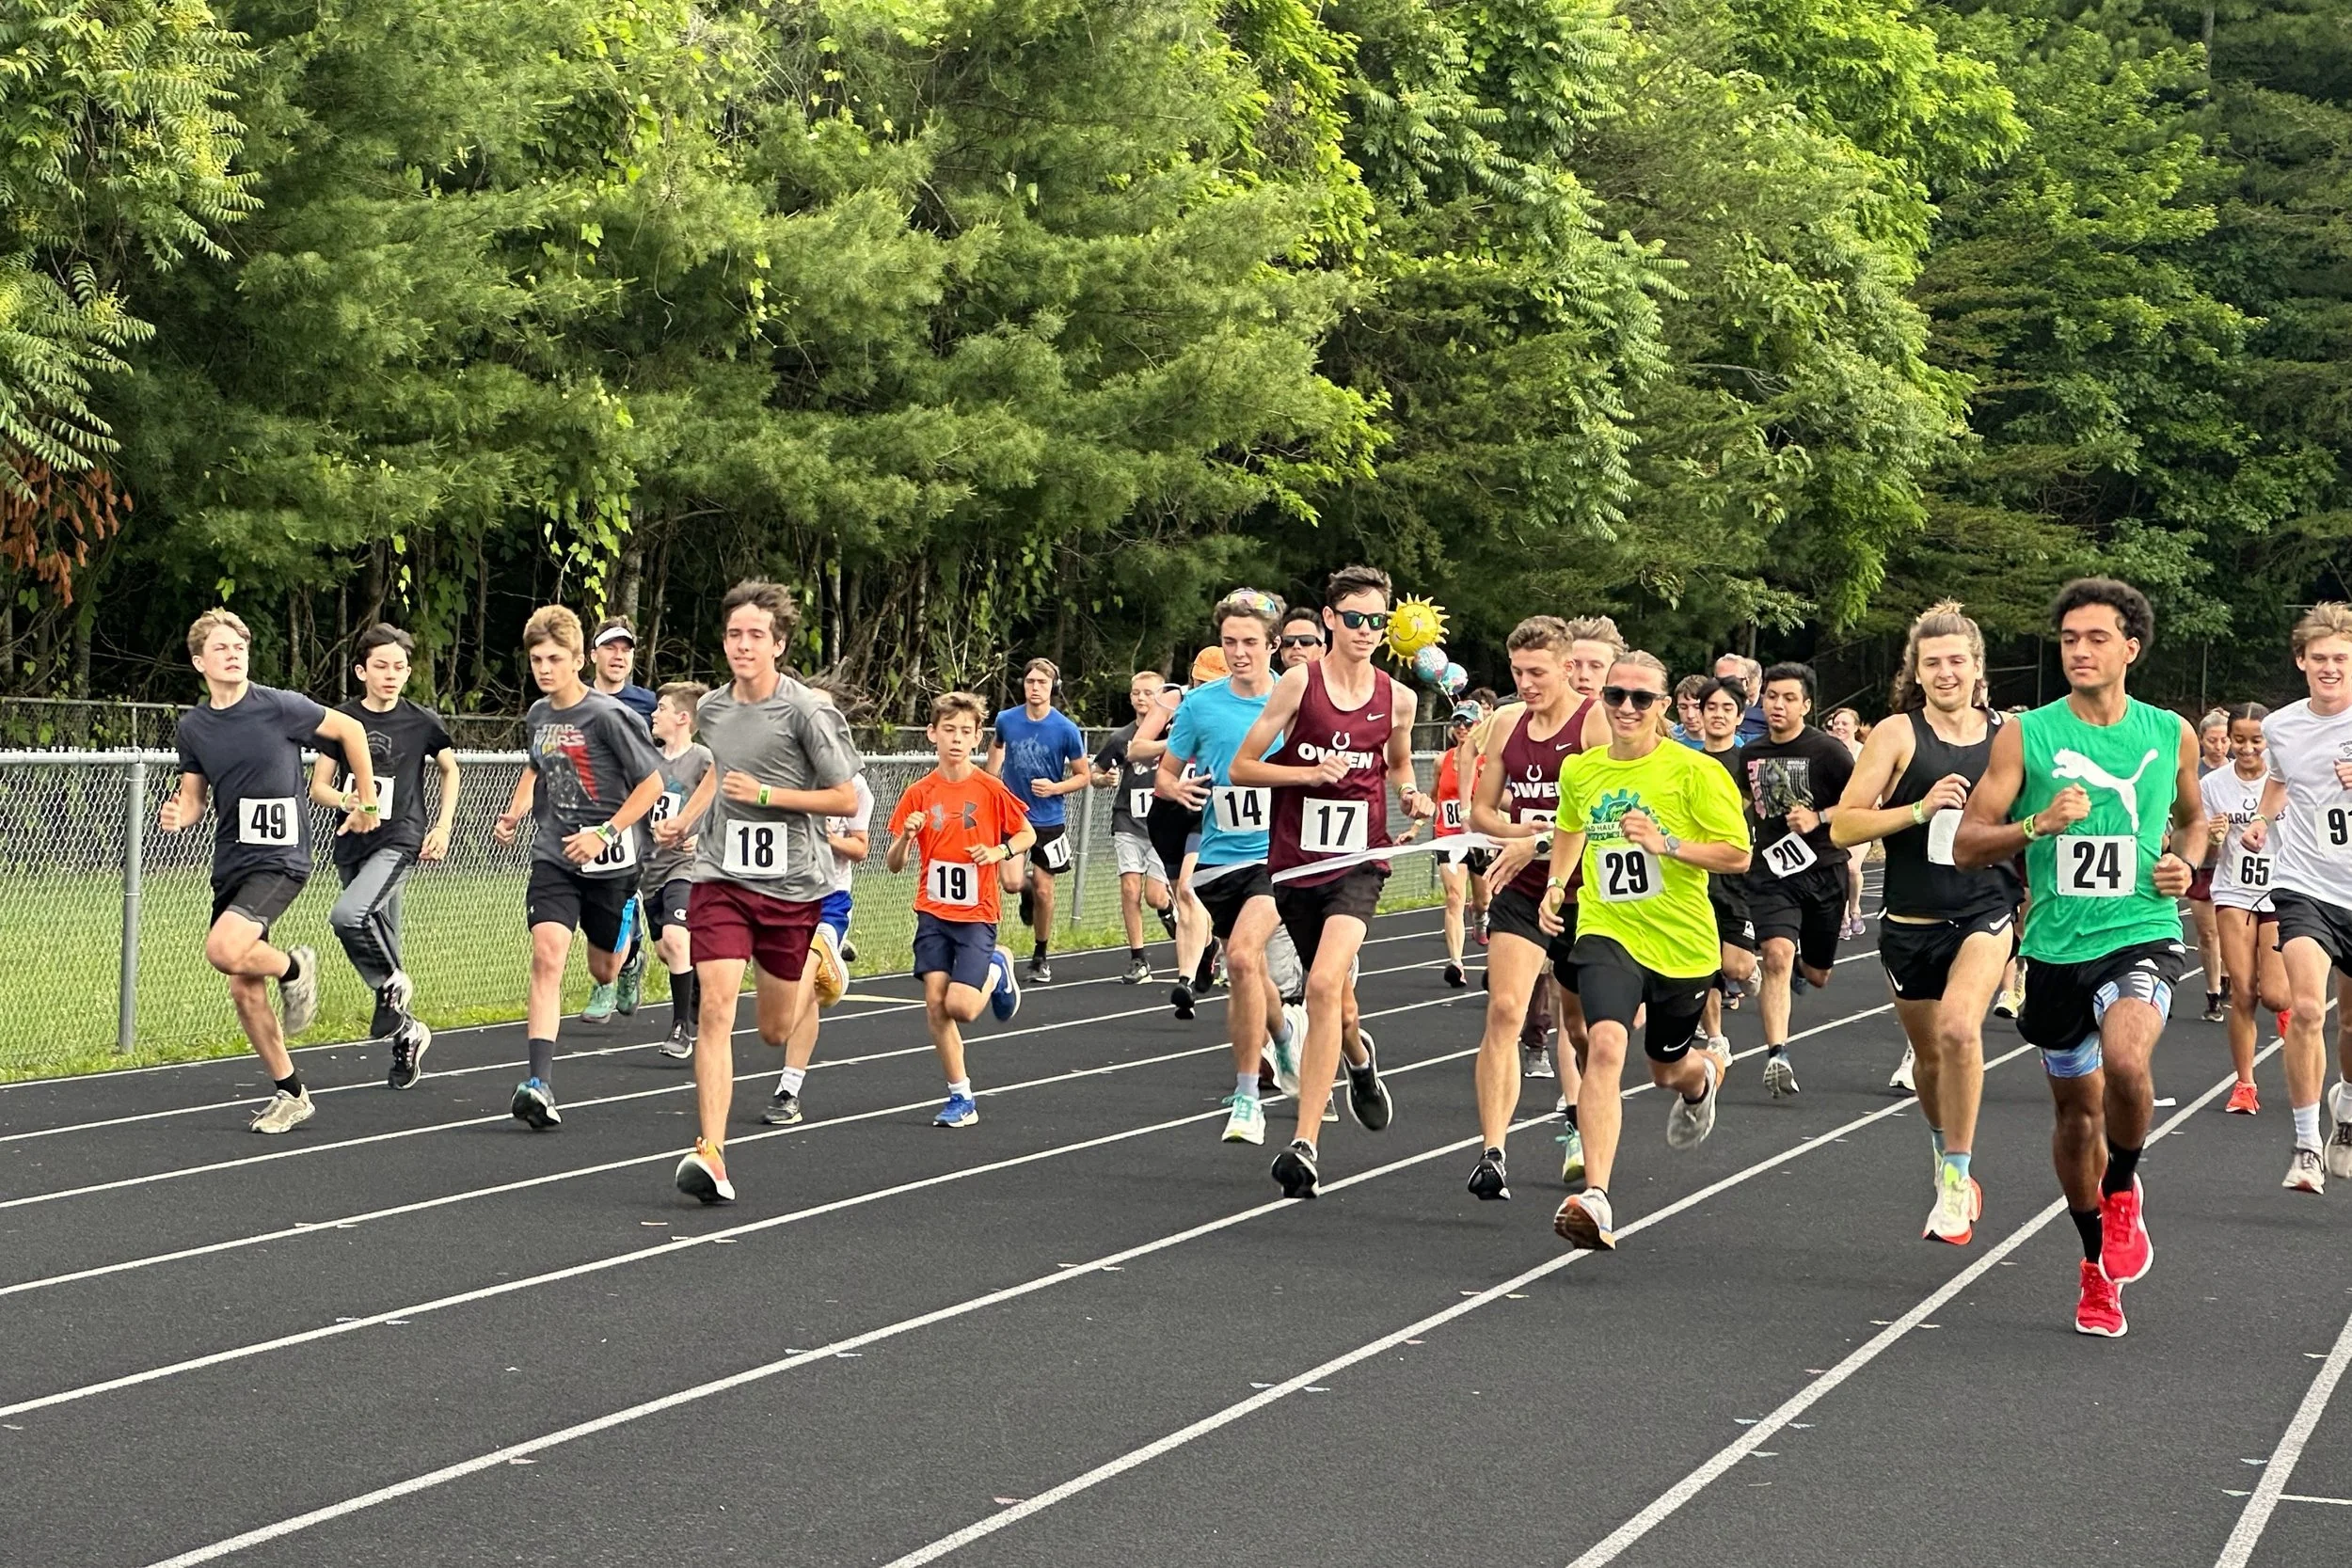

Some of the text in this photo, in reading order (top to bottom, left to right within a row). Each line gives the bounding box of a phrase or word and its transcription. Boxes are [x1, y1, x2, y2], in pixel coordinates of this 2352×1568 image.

[532, 732, 586, 749] WARS
[535, 723, 581, 734] STAR
[251, 803, 286, 839] 49
[650, 796, 669, 822] 3
[1225, 789, 1262, 827] 14
[1318, 805, 1356, 846] 17
[738, 826, 773, 867] 18
[1772, 839, 1806, 872] 20
[936, 865, 967, 900] 19
[1605, 850, 1649, 895] 29
[2073, 841, 2122, 889] 24
[2240, 855, 2270, 886] 65
